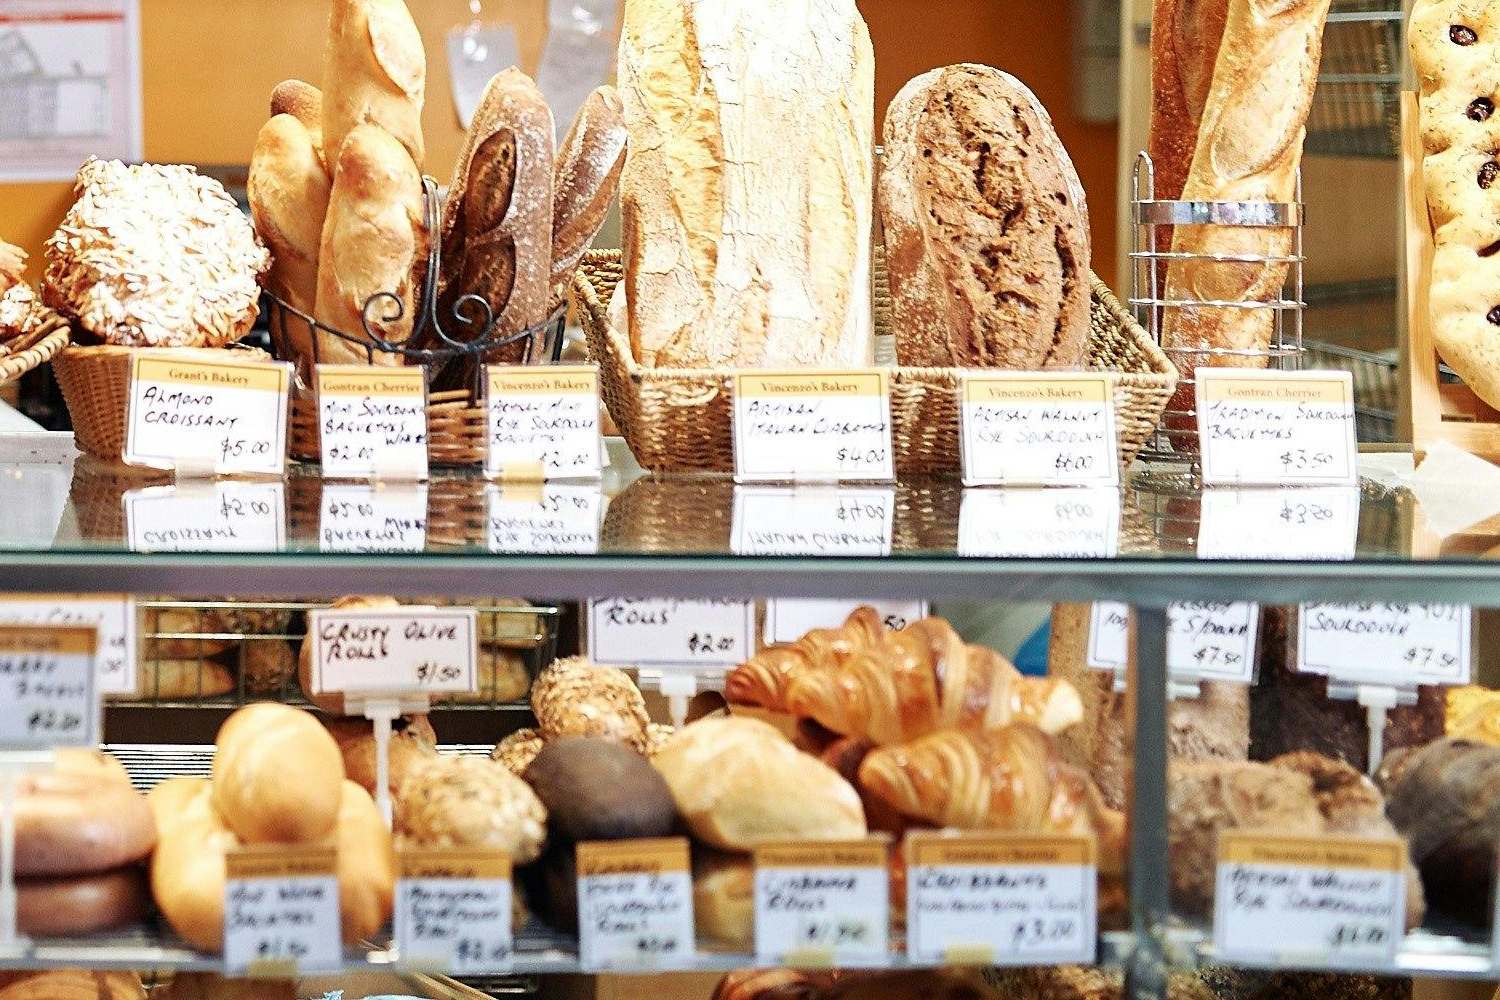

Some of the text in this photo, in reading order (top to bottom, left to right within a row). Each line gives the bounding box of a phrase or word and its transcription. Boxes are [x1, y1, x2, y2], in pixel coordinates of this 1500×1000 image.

[169, 369, 250, 388] Grant's Bakery
[323, 381, 421, 392] Gontran Cherrier
[493, 380, 591, 391] Vincenzo's Bakery
[761, 381, 860, 394] Vincenzo's Bakery
[143, 386, 213, 409] ALMOND
[988, 387, 1083, 399] Vincenzo's Bakery
[1228, 387, 1323, 398] Gontran Cherrier
[144, 411, 238, 429] CROISSANT
